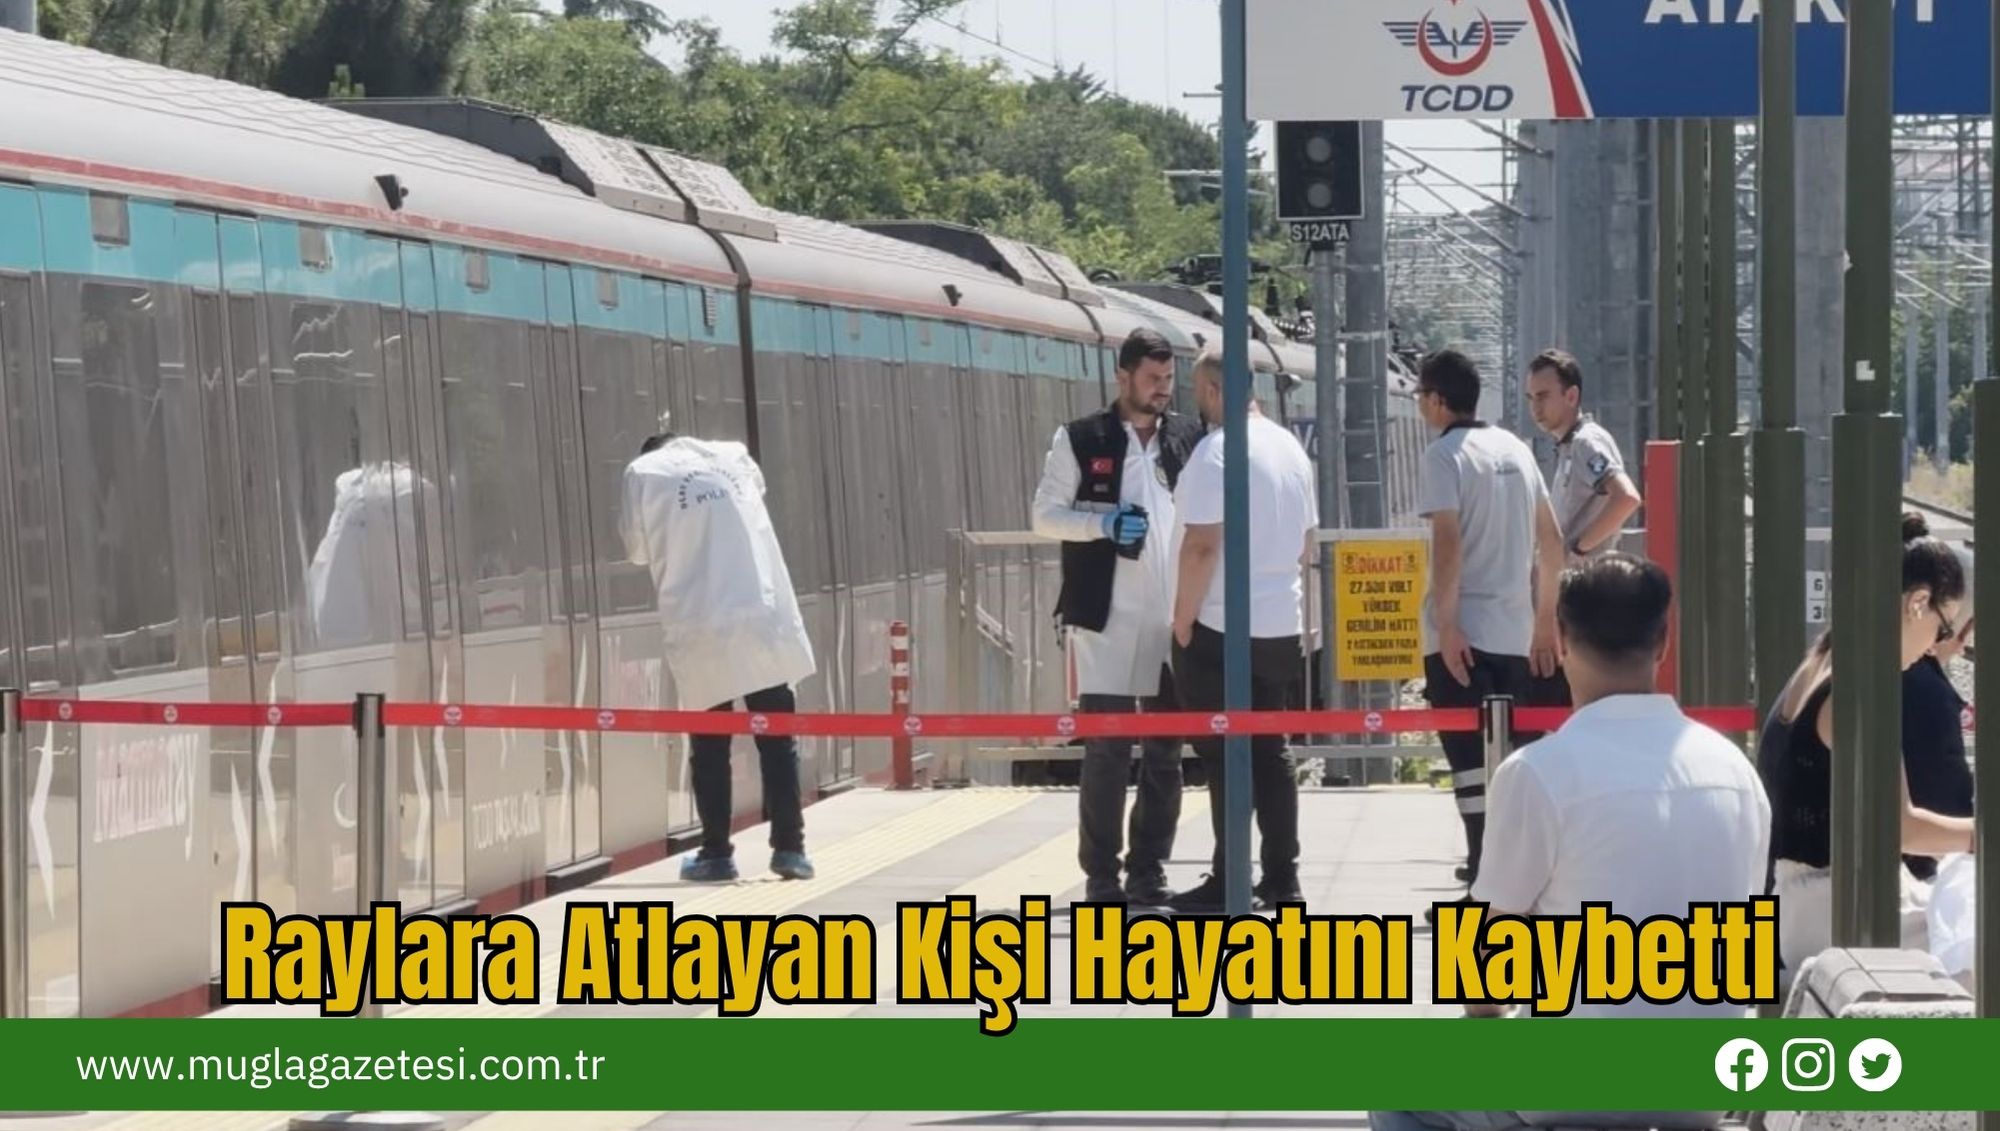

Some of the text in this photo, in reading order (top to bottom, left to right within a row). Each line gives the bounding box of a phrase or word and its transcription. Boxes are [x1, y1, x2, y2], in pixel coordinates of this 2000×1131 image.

[1400, 84, 1514, 112] TCDD
[1292, 223, 1350, 241] S12ATA
[1358, 553, 1401, 574] DİKKAT
[1389, 580, 1413, 594] VOLT
